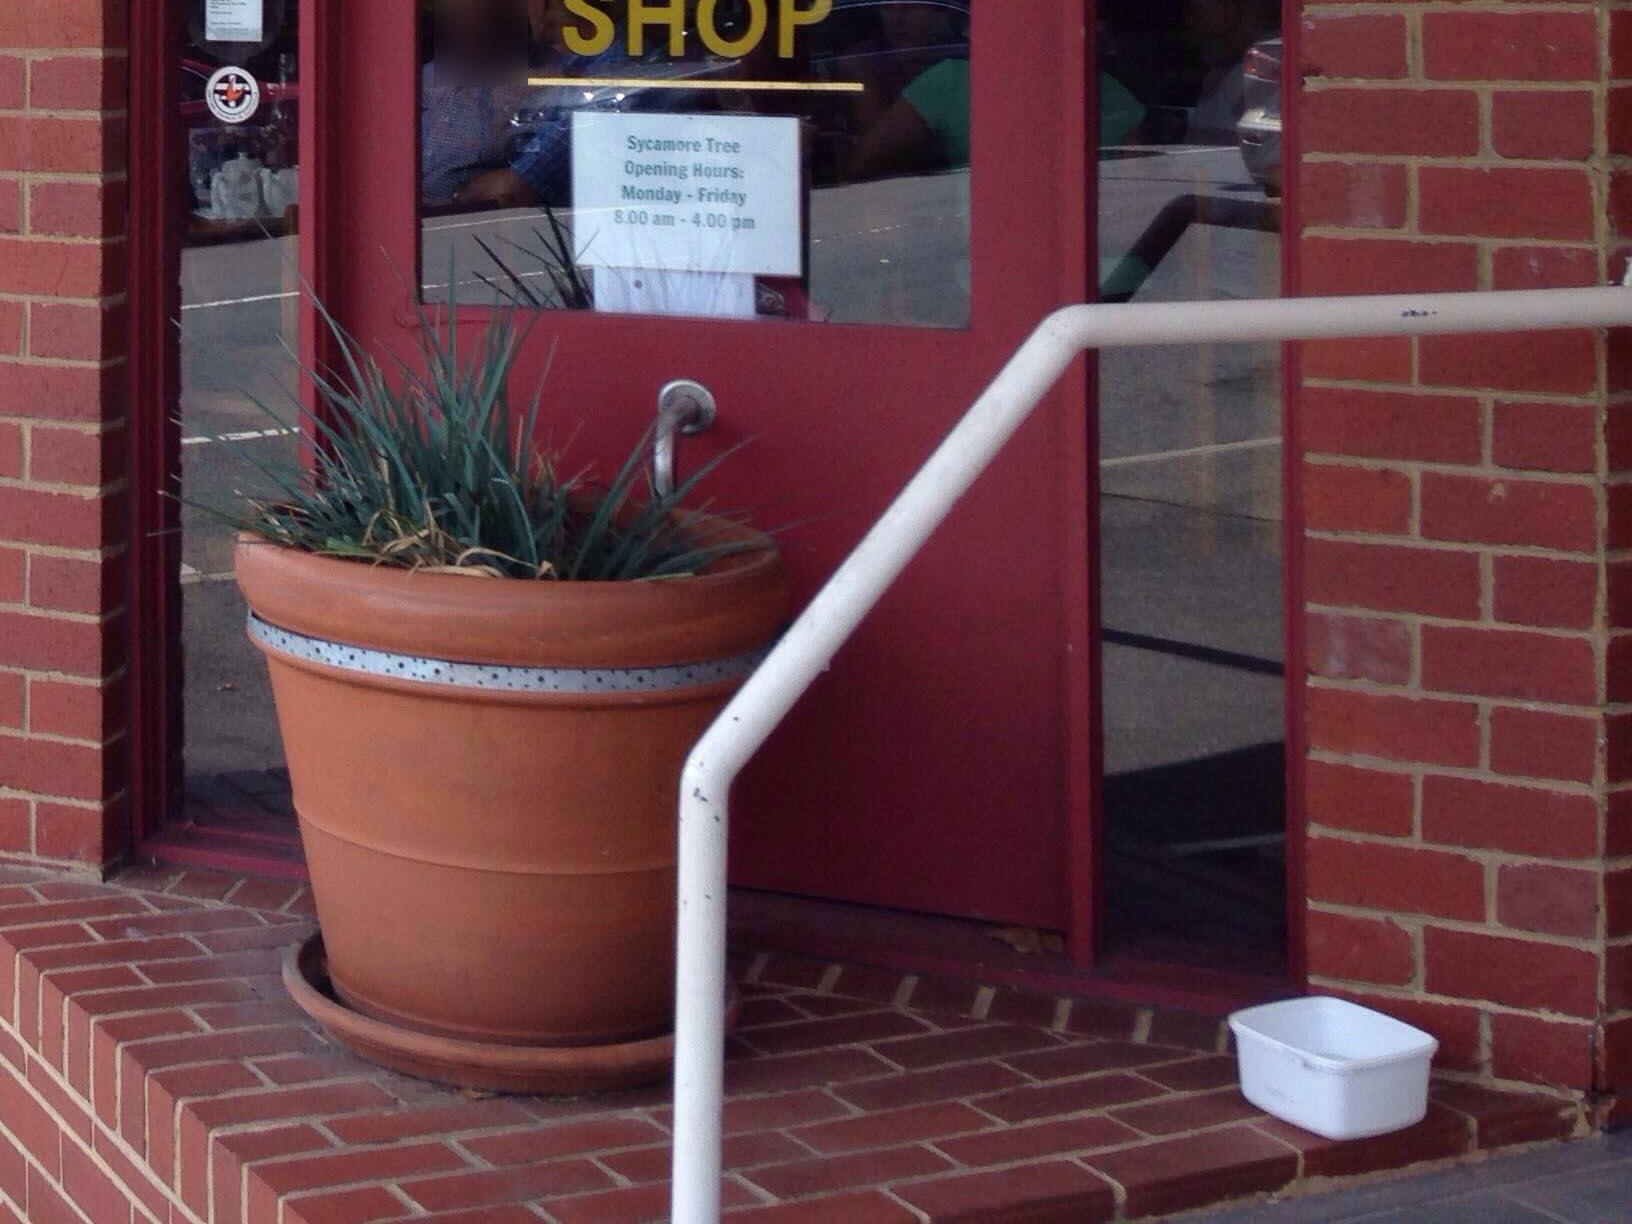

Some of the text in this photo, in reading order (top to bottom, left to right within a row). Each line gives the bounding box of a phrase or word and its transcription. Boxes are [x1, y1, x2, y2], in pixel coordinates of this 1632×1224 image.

[627, 135, 741, 154] Sycamore Tree
[624, 160, 745, 180] Opening Hours:
[621, 185, 682, 204] Monday
[698, 187, 747, 207] Friday
[614, 209, 648, 225] 8.00
[652, 213, 675, 226] am
[692, 212, 727, 228] 4.00
[731, 216, 756, 232] pm
